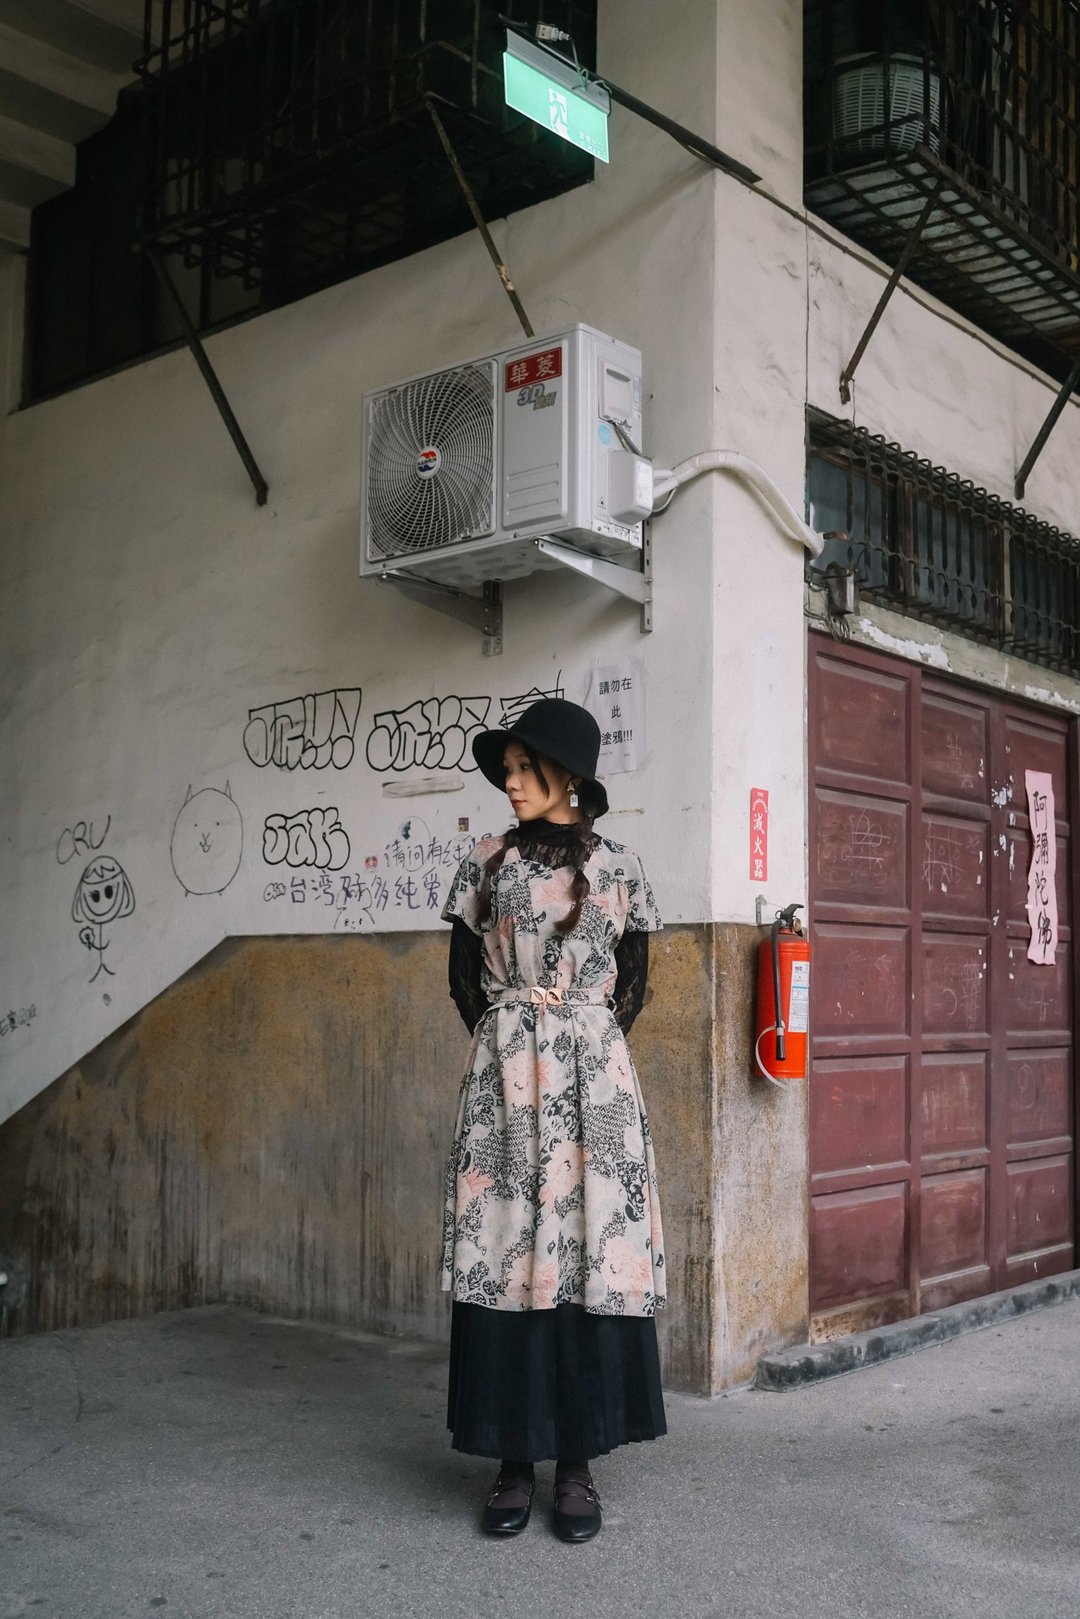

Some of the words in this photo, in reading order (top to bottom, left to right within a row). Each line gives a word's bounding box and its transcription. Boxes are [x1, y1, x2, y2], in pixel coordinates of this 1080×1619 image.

[510, 354, 556, 384] 華菱
[517, 383, 545, 406] 3D
[599, 678, 633, 695] 請勿在
[611, 705, 622, 719] 此
[753, 812, 765, 878] 滅火器
